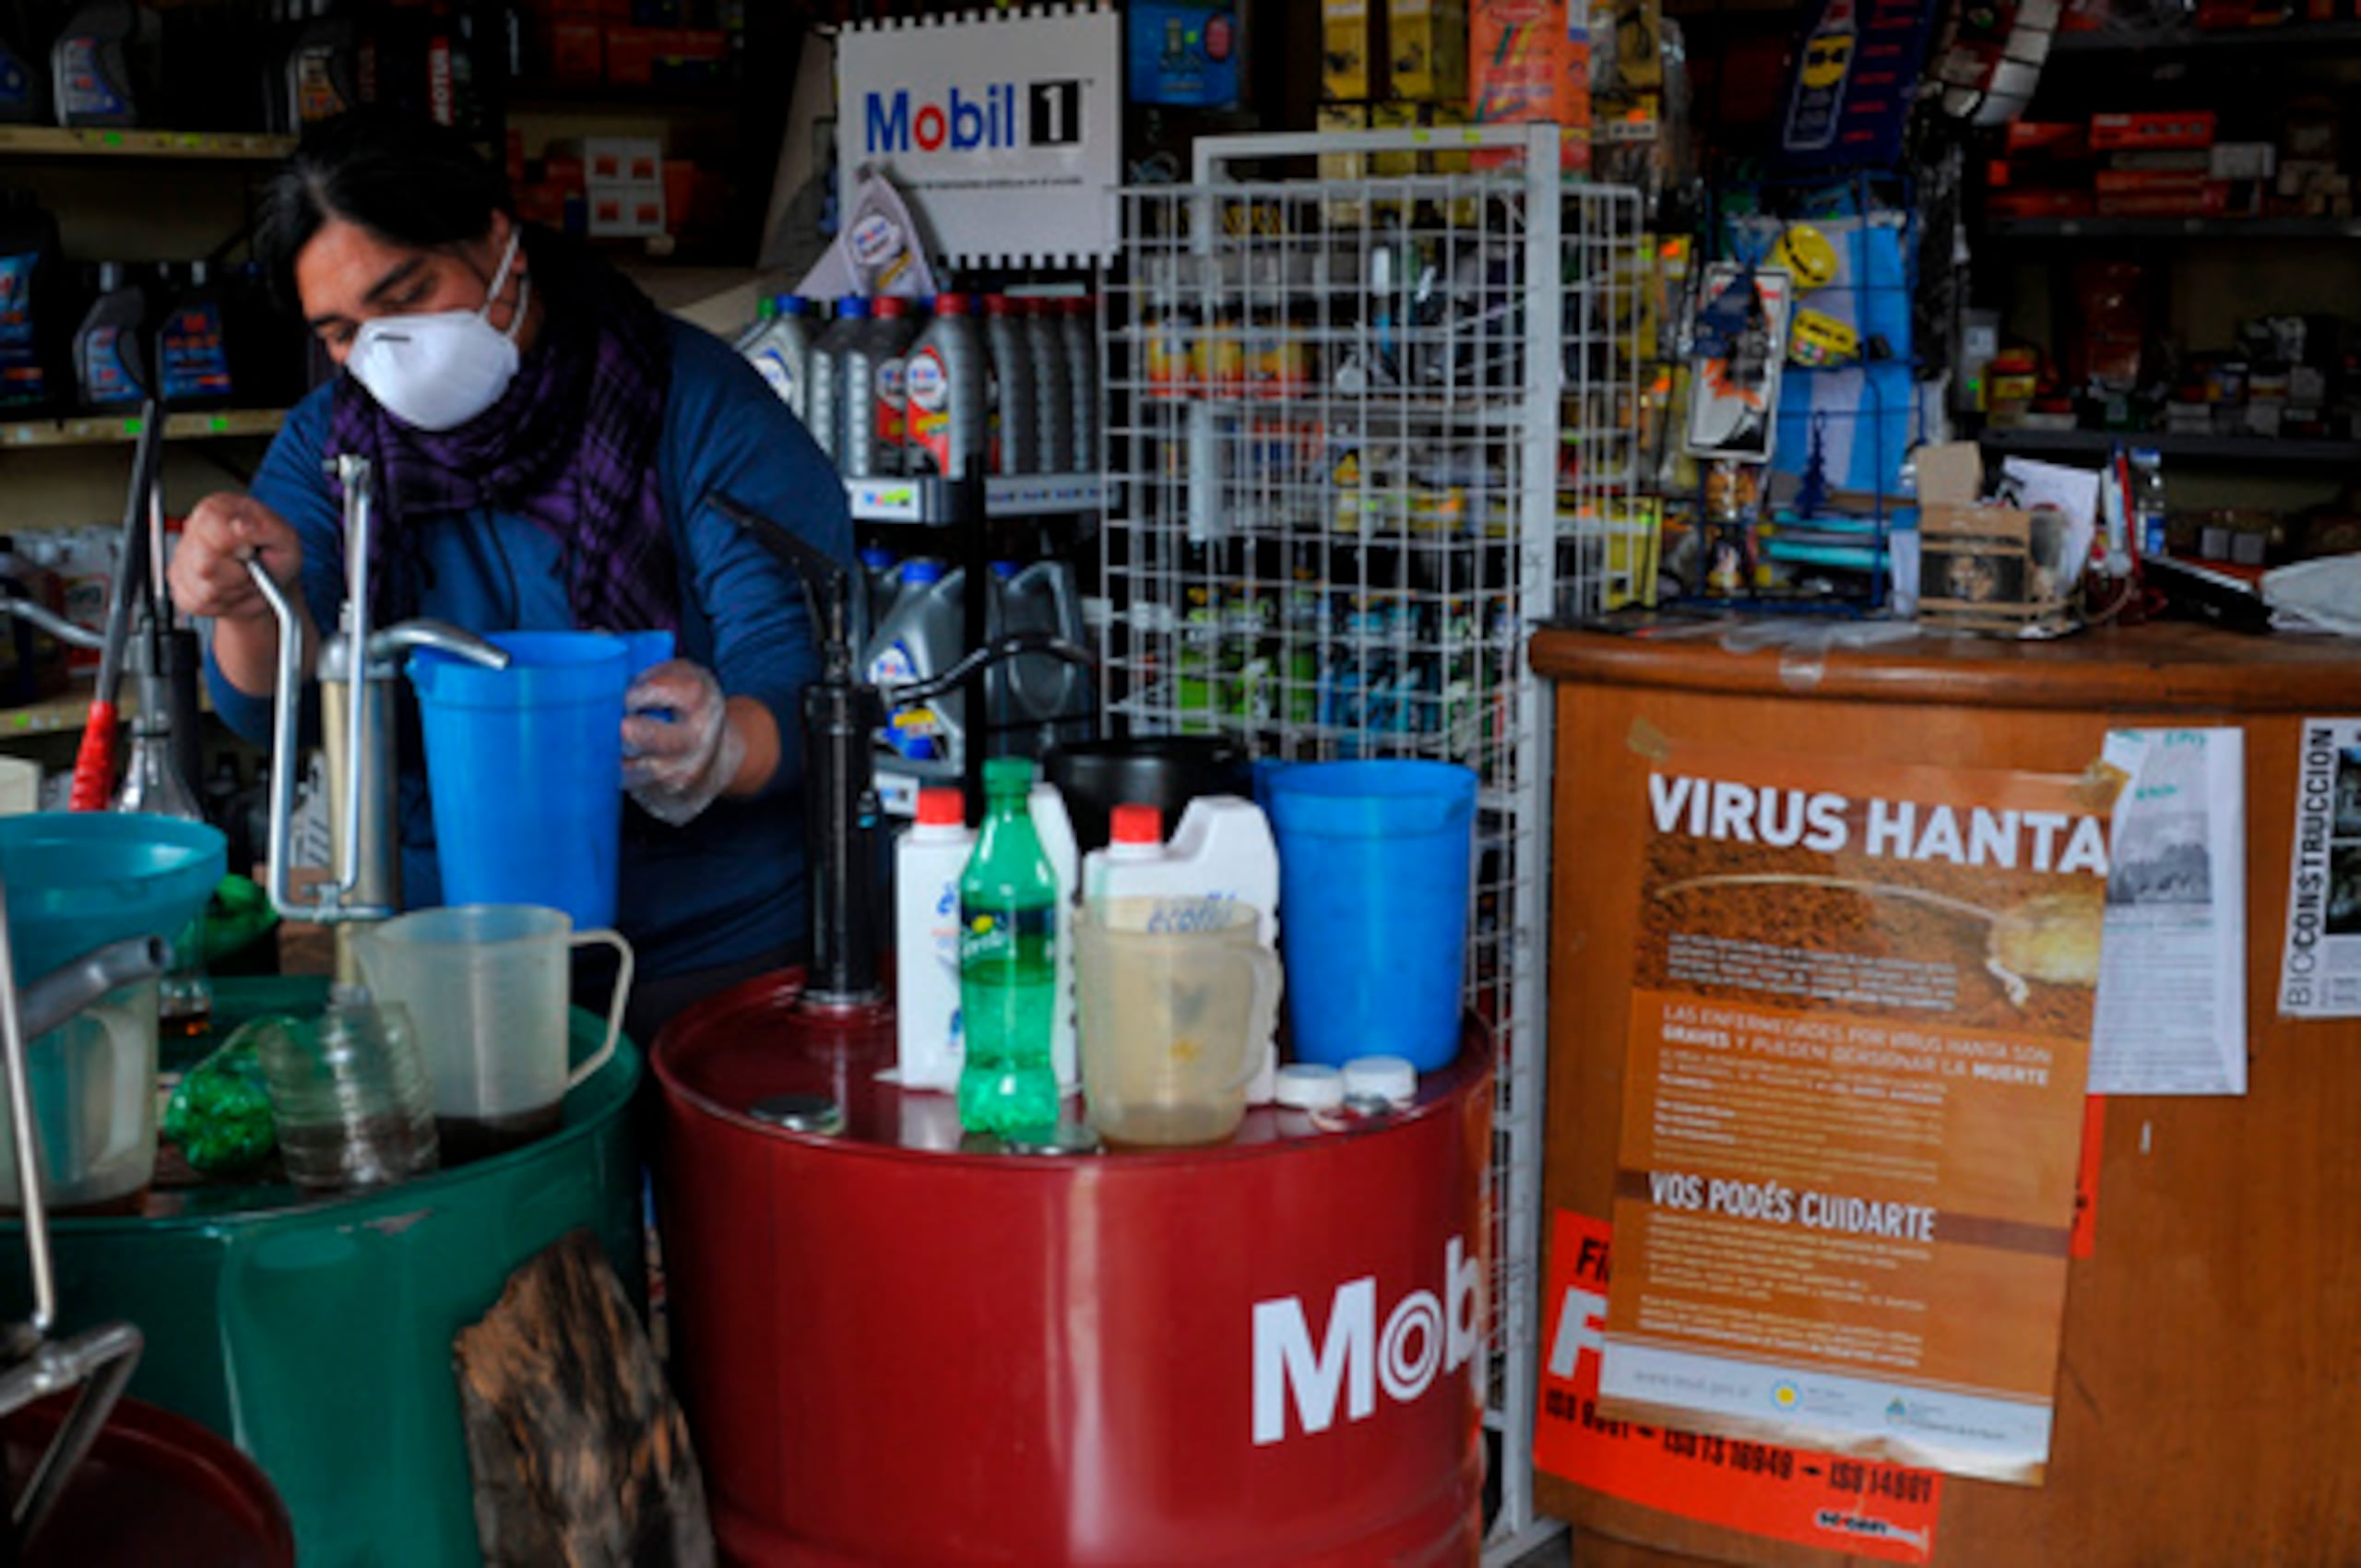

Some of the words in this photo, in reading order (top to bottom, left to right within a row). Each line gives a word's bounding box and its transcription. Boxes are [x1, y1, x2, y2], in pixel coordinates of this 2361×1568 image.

[864, 83, 1014, 153] Mobil
[1649, 773, 1848, 852] VIRUS
[1865, 797, 2109, 877] HANTA
[1663, 1004, 1698, 1026] LAS
[1847, 1027, 1887, 1047] POR
[1890, 1029, 1941, 1054] VIRUS
[1947, 1036, 2008, 1059] HANTA
[2011, 1043, 2052, 1064] SON
[1663, 1023, 1729, 1048] GRAVES
[1752, 1035, 1826, 1063] PUEDEN
[1831, 1043, 1935, 1074] OCASIONAR
[1941, 1055, 1966, 1075] LA
[1971, 1058, 2048, 1087] MUERTE
[1648, 1170, 1703, 1210] VOS
[1708, 1178, 1794, 1224] PODÉS
[1800, 1191, 1935, 1242] CUIDARTE
